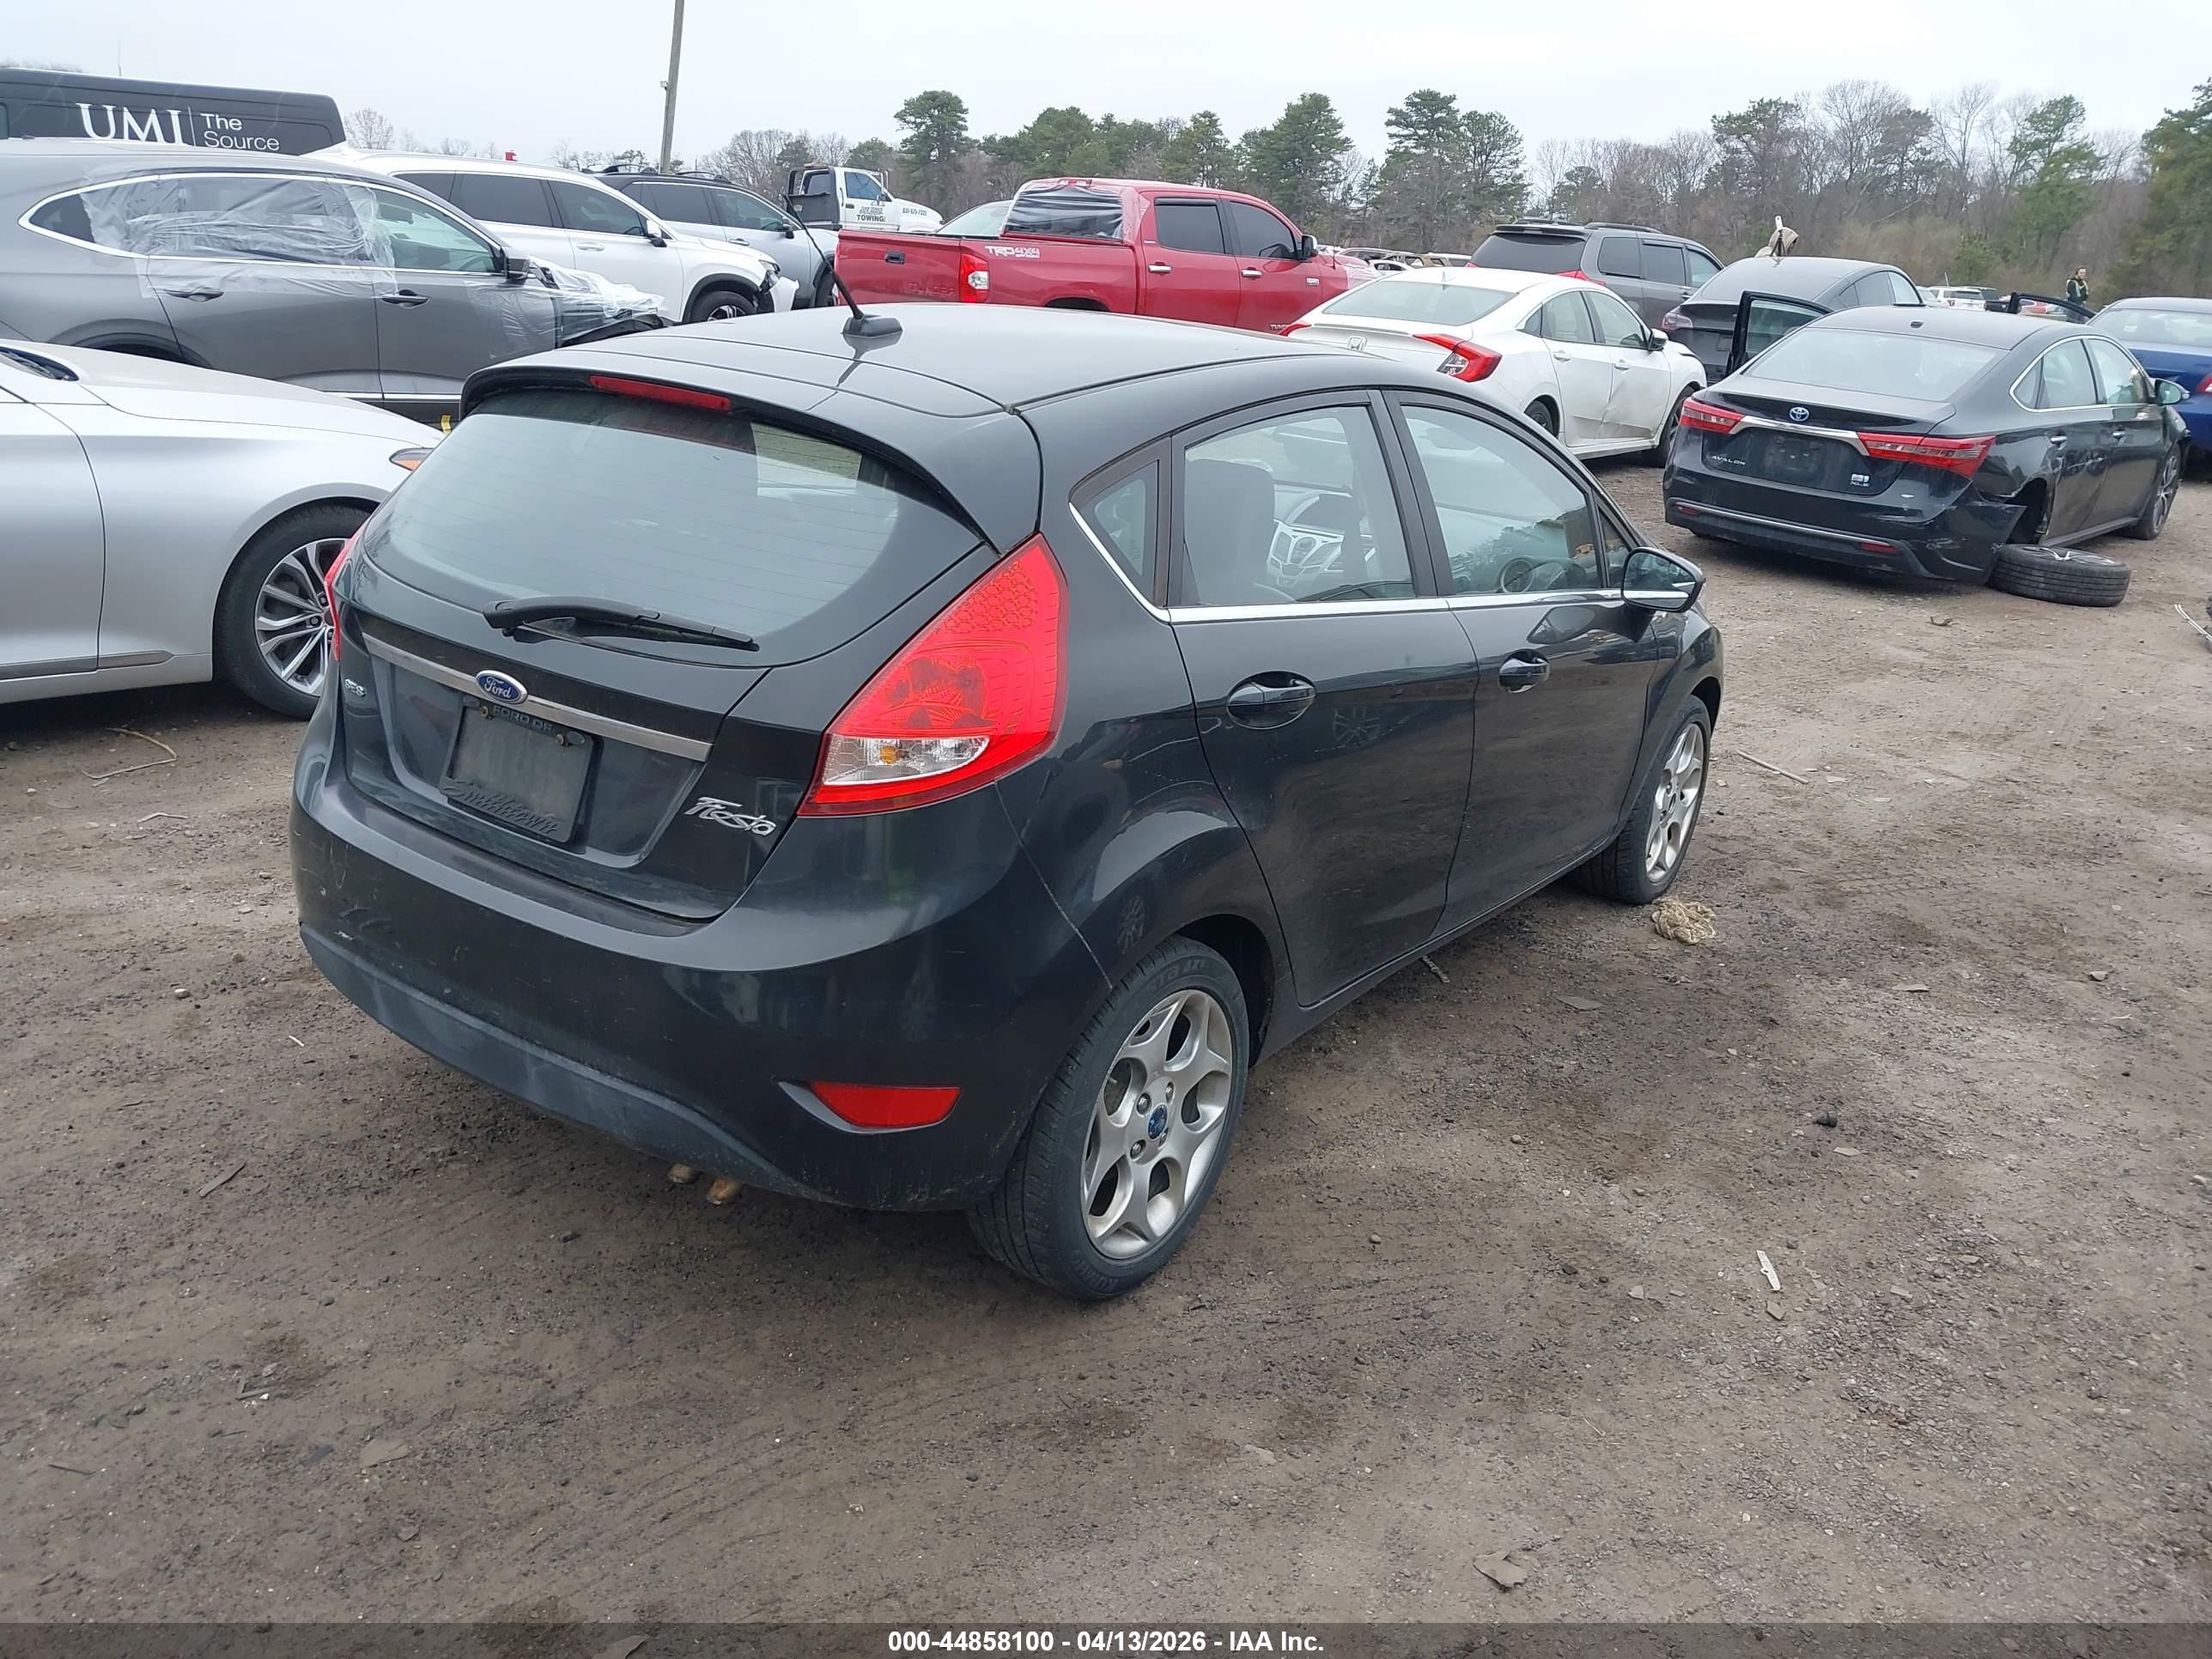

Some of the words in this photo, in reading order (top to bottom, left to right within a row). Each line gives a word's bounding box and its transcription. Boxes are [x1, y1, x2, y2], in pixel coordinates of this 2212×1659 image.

[76, 102, 189, 145] UMI
[200, 112, 242, 131] The
[204, 131, 280, 151] Source
[856, 214, 884, 222] TOWING
[1711, 455, 1746, 465] AVALON
[344, 678, 364, 696] SES
[484, 676, 513, 699] Ford
[494, 705, 530, 725] FORD
[532, 719, 553, 732] OF
[684, 796, 777, 836] Fiesta
